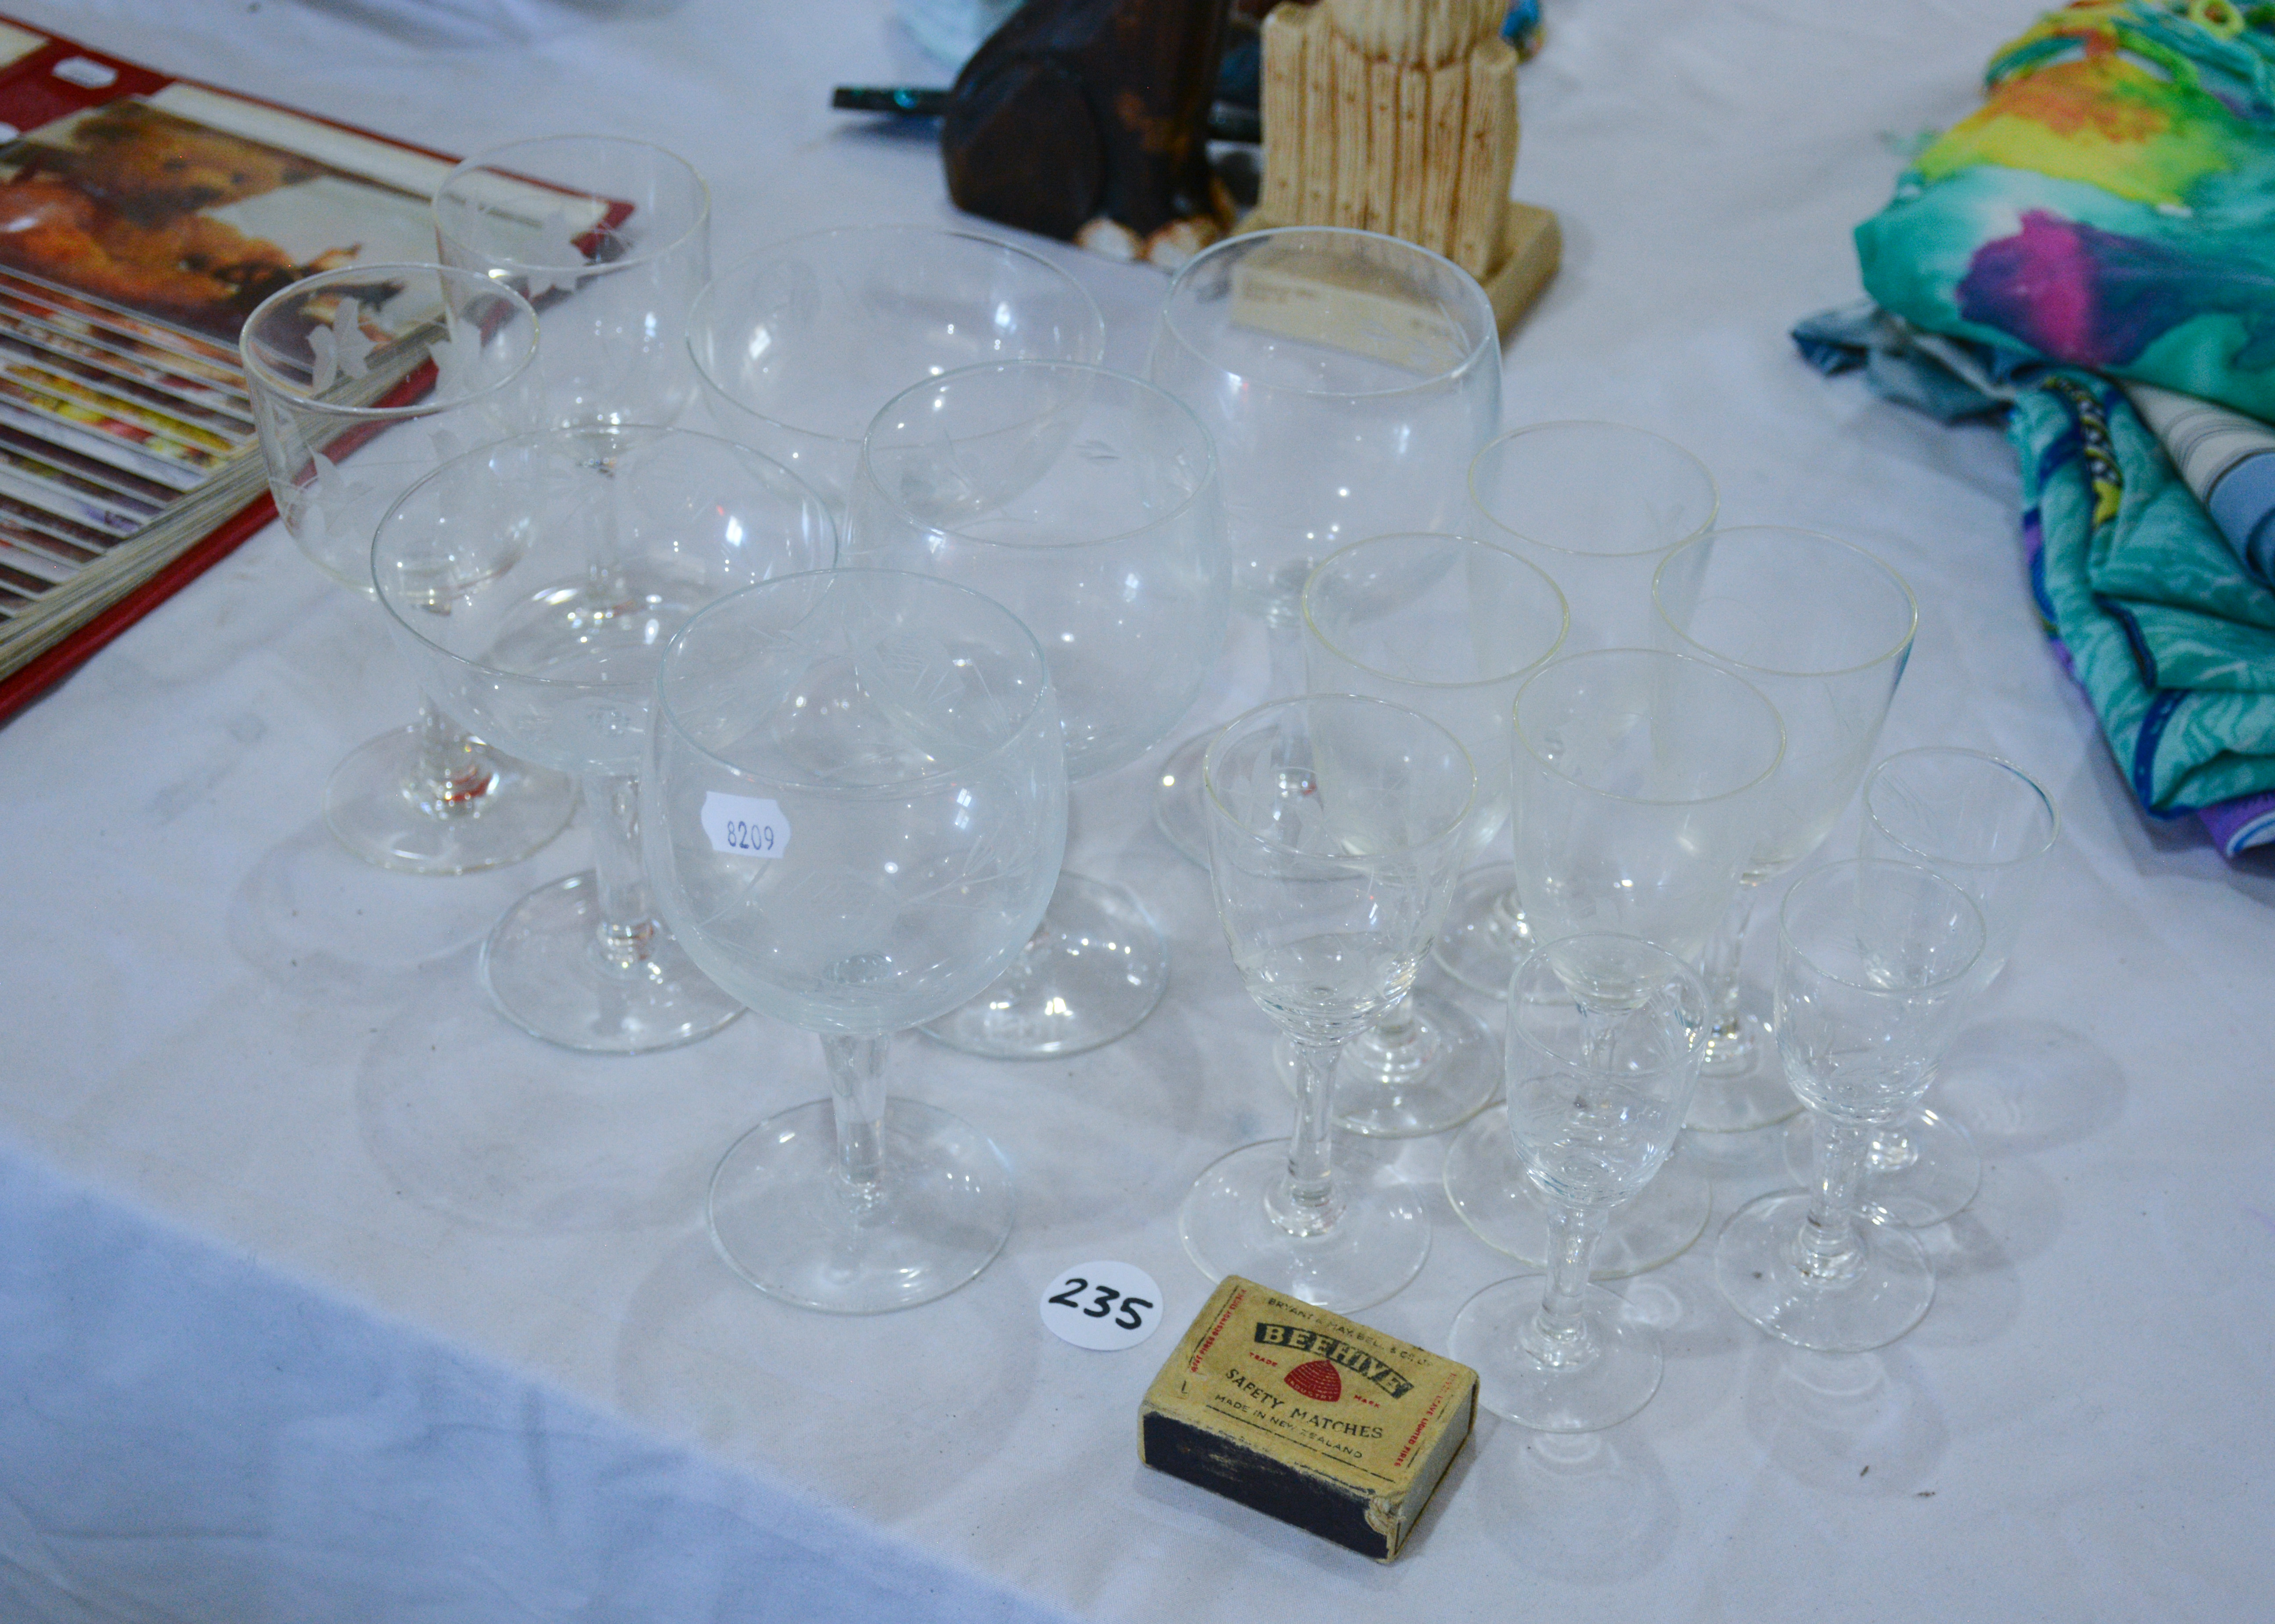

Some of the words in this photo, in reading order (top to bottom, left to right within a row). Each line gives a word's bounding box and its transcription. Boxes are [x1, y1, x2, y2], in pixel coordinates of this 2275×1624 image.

[727, 820, 774, 850] 8209
[1048, 1278, 1154, 1330] 235
[1249, 1352, 1278, 1367] TRADE
[1353, 1394, 1381, 1408] MARK
[1263, 1325, 1405, 1395] BEEHIVE
[1226, 1368, 1285, 1409] SAFETY
[1289, 1408, 1383, 1439] MATCHES
[1287, 1378, 1334, 1399] INDUSTRY
[1215, 1394, 1250, 1413] MADE
[1253, 1409, 1266, 1420] IN
[1270, 1416, 1296, 1431] NEW
[1299, 1429, 1363, 1459] ZEALAND
[1408, 1417, 1429, 1445] LIGHTED
[1394, 1445, 1411, 1467] FIRES
